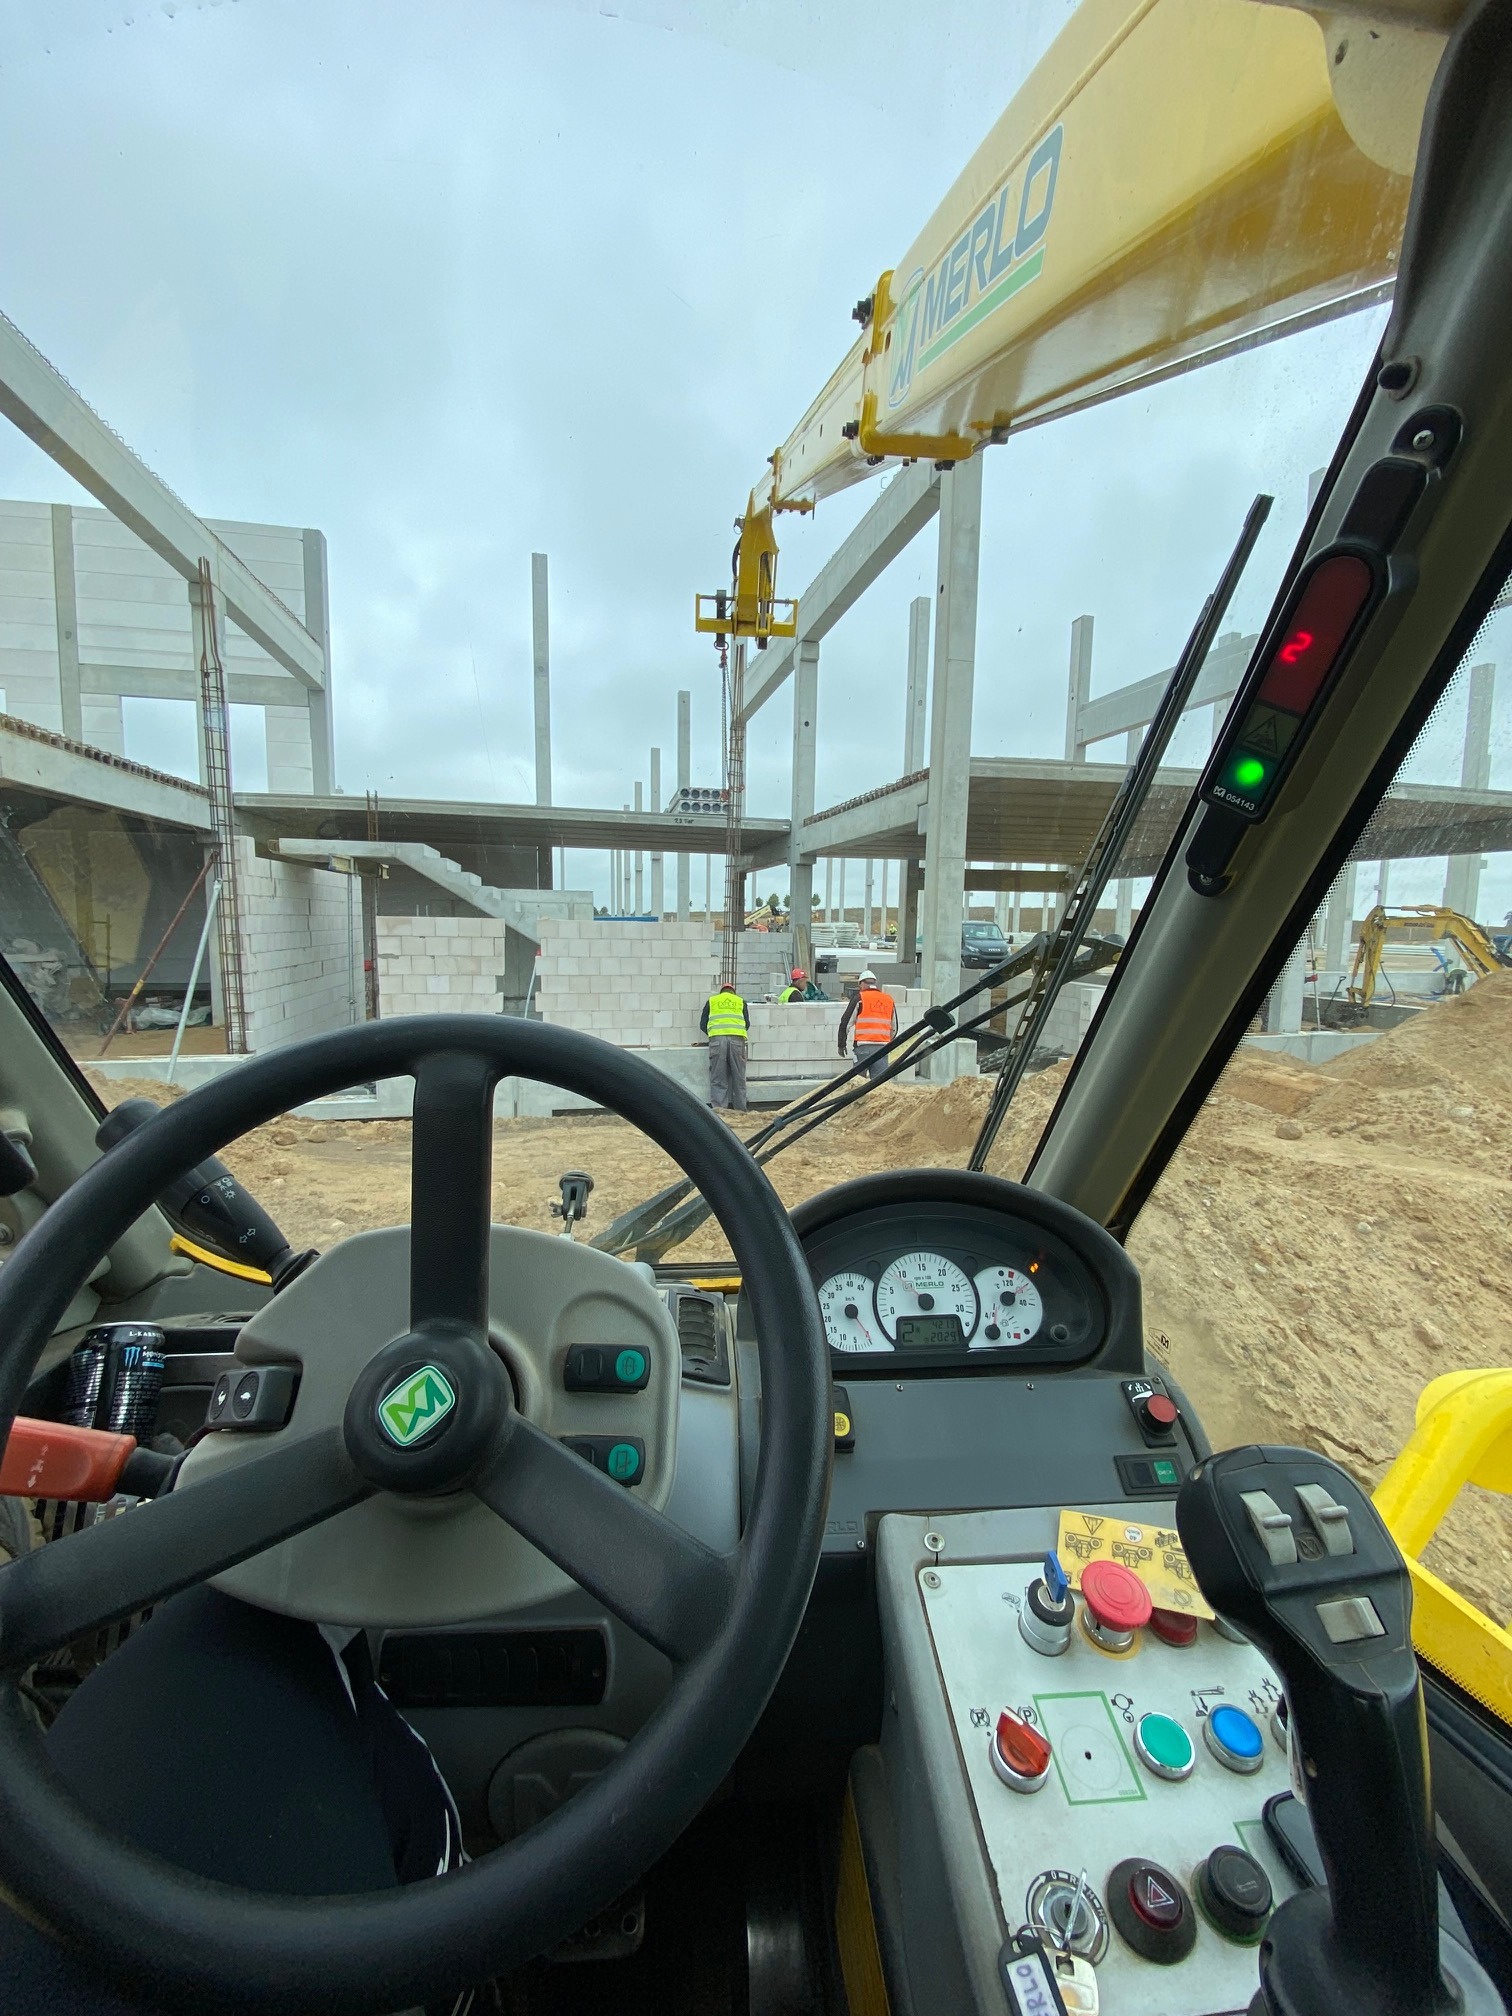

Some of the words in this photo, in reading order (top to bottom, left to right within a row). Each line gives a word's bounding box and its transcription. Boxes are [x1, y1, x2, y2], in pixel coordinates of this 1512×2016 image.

[920, 122, 1064, 348] MERLO
[1279, 630, 1314, 664] 2
[1226, 794, 1255, 810] 054143
[918, 1263, 926, 1271] 15
[898, 1270, 907, 1278] 10
[951, 1284, 960, 1292] 25
[890, 1306, 895, 1314] 0
[955, 1304, 964, 1312] 30
[902, 1322, 914, 1342] 2
